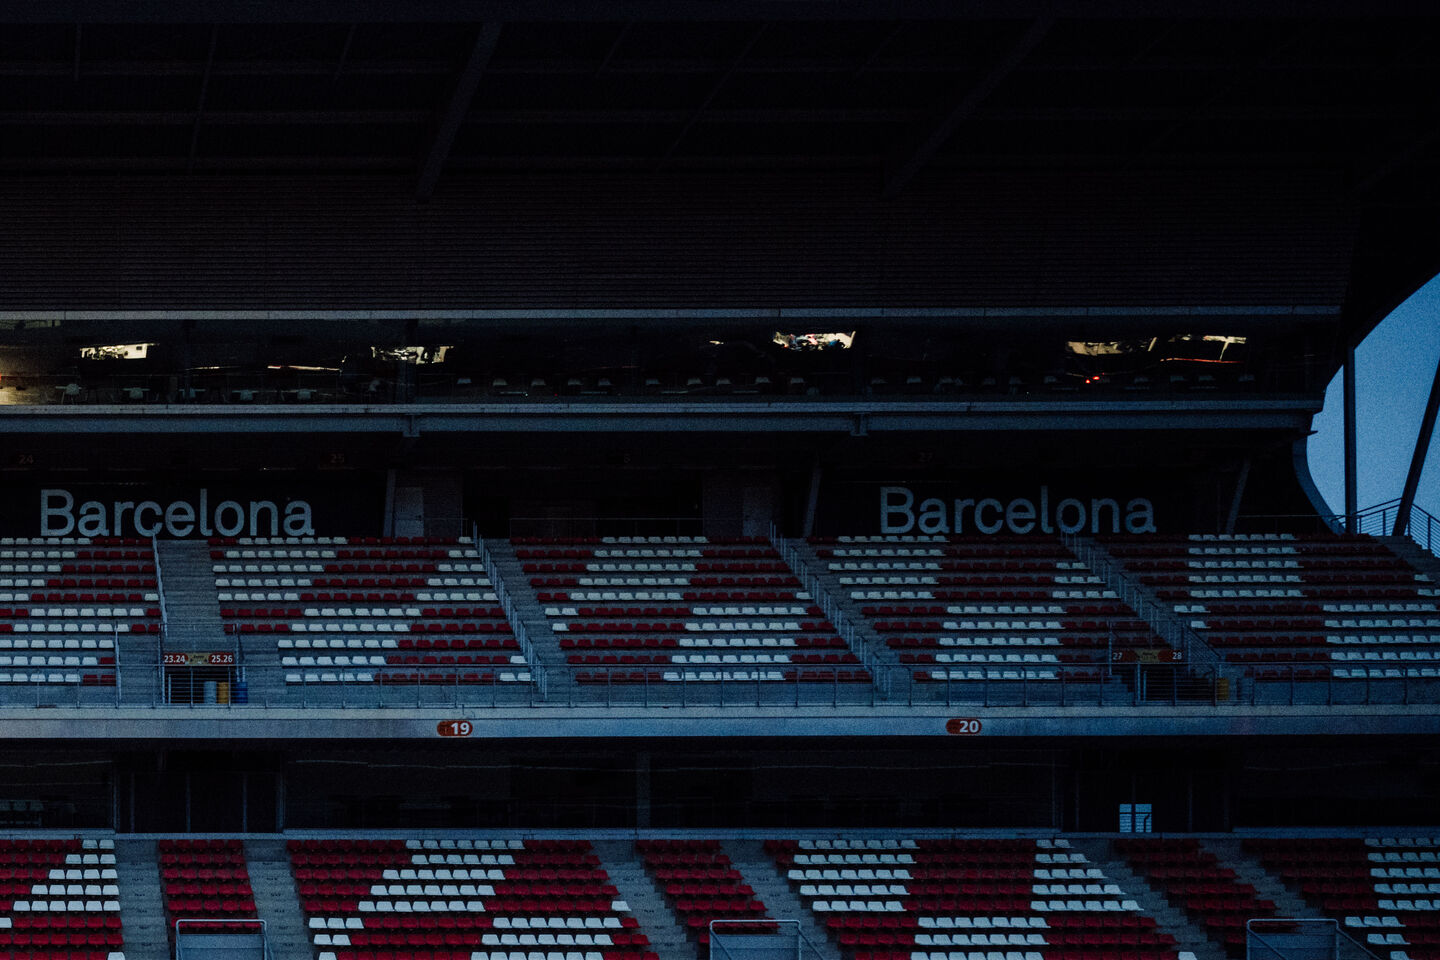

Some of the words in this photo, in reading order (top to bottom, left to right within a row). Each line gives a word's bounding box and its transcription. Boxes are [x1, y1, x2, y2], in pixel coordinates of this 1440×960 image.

[40, 488, 315, 537] Barcelona
[879, 485, 1157, 535] Barcelona
[163, 655, 186, 663] 23.24
[211, 655, 233, 663] 25.26
[1172, 652, 1183, 660] 28
[451, 722, 470, 735] 19
[959, 720, 979, 734] 20
